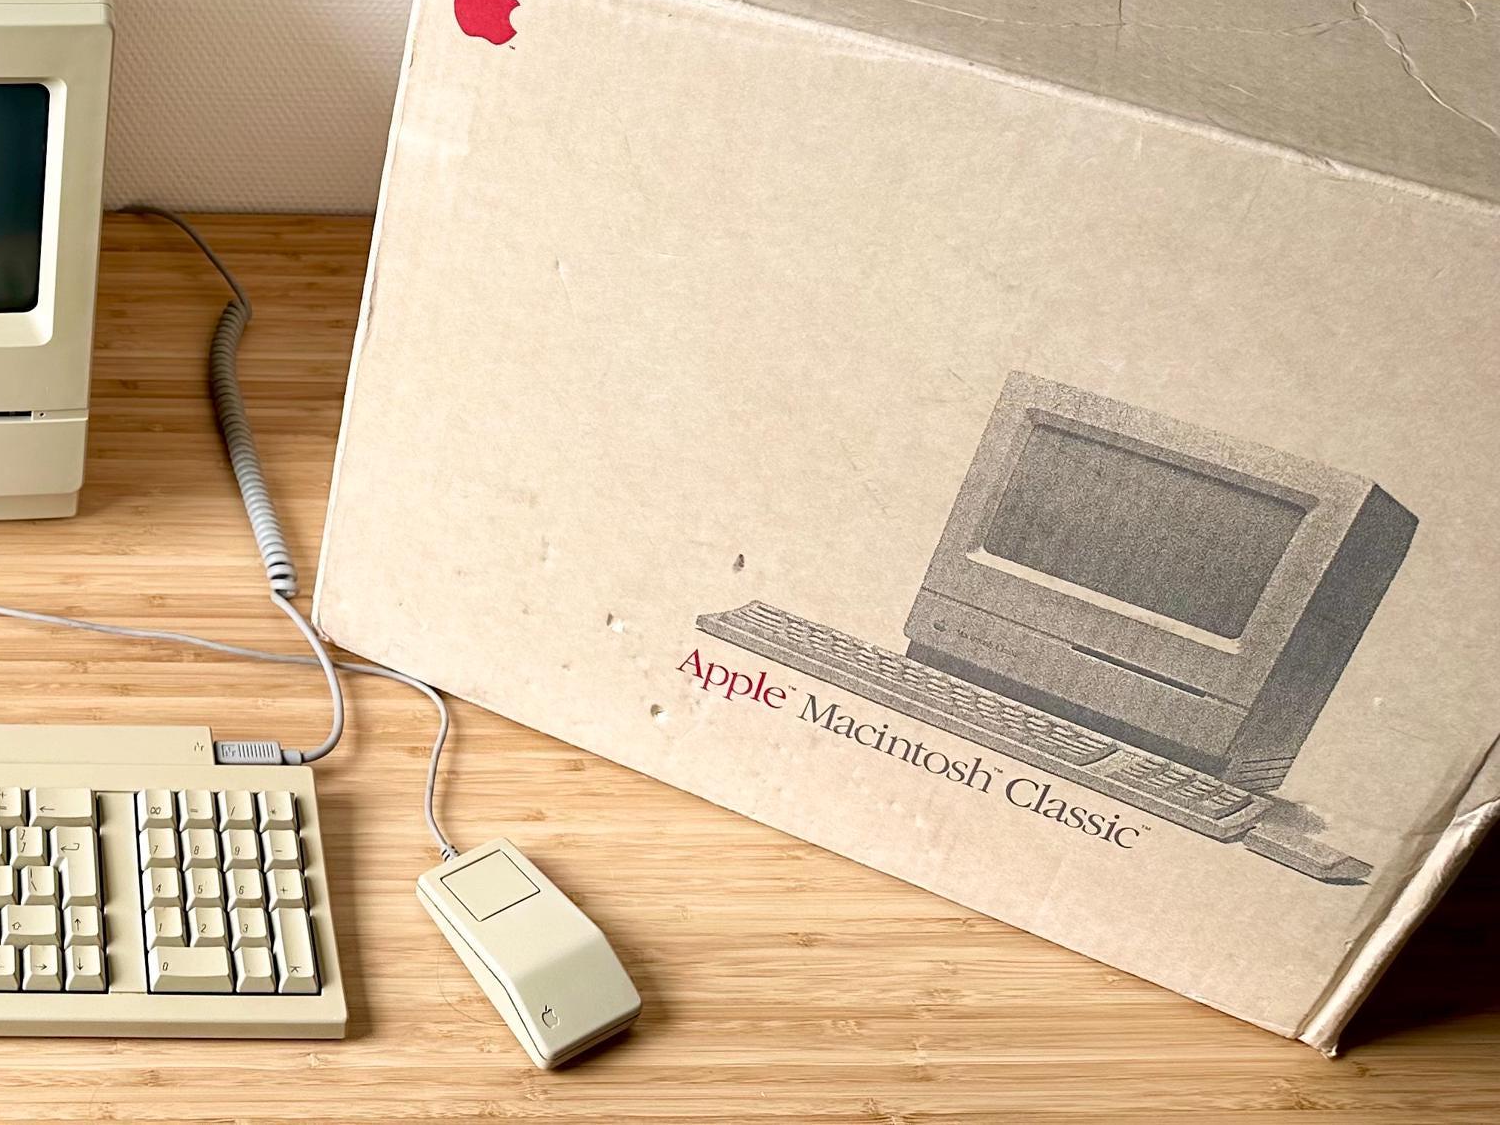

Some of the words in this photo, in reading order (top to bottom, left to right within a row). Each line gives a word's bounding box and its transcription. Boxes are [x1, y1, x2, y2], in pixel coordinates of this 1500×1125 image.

[152, 844, 160, 855] 7
[192, 845, 201, 856] 8
[234, 846, 241, 856] 9
[155, 883, 163, 894] 4
[196, 884, 204, 895] 5
[238, 885, 245, 895] 6
[200, 923, 207, 934] 2
[242, 923, 249, 933] 3
[162, 961, 169, 972] 0
